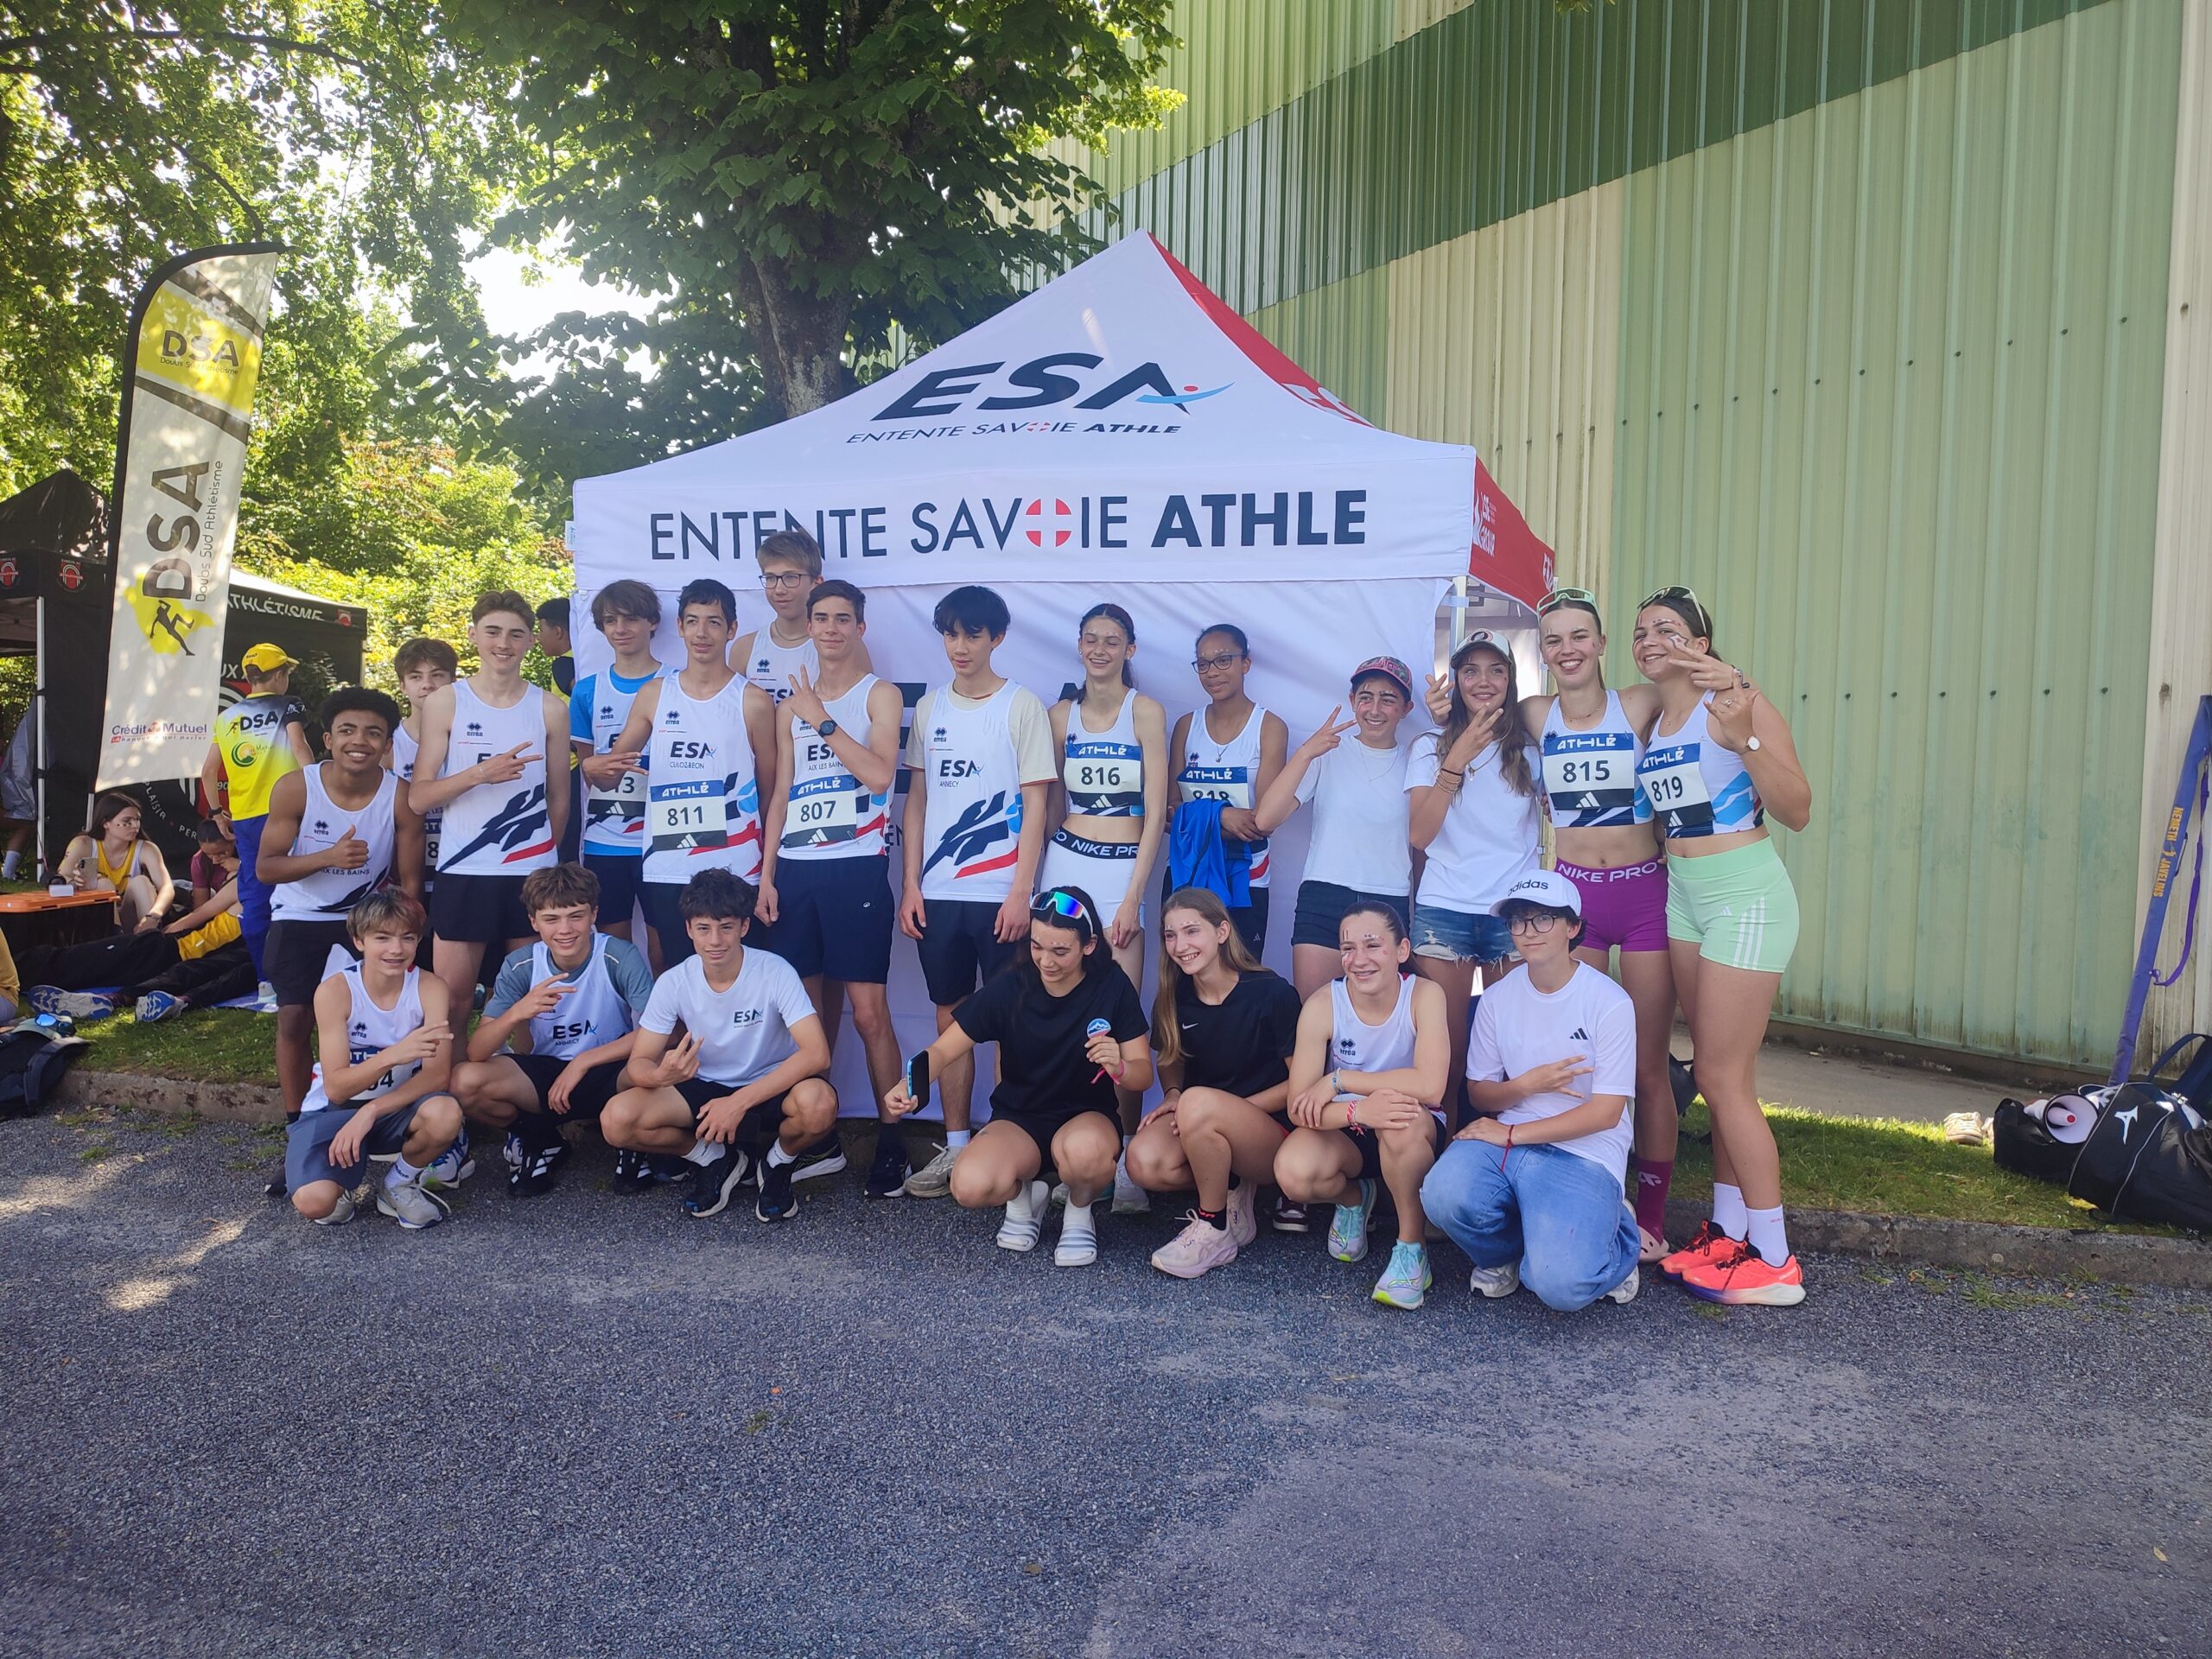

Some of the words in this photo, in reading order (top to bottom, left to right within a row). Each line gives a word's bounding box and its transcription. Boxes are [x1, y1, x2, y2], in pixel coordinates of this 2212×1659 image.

[162, 330, 239, 367] DSA
[871, 352, 1192, 422] ESA
[845, 425, 966, 444] ENTENTE
[1082, 423, 1182, 434] ATHLE
[204, 461, 223, 530] Athlétisme
[1151, 489, 1367, 549] ATHLE
[143, 461, 210, 600] DSA
[200, 534, 213, 559] Sud
[195, 563, 211, 602] Doubs
[111, 724, 147, 735] Crédit
[162, 722, 207, 733] Mutuel
[240, 710, 279, 731] DSA
[670, 741, 715, 760] ESA
[1078, 745, 1128, 756] ATHLÉ
[1557, 734, 1617, 750] ATHLÉ
[1643, 747, 1684, 769] ATHLÉ
[939, 760, 982, 778] ESA
[1081, 766, 1121, 786] 816
[1185, 767, 1233, 780] ATHLÉ
[1562, 760, 1611, 783] 815
[662, 781, 709, 798] ATHLÉ
[798, 777, 842, 796] ATHLÉ
[1651, 776, 1683, 803] 819
[667, 805, 704, 827] 811
[800, 800, 836, 823] 807
[2166, 806, 2184, 842] NEMETH
[1071, 839, 1113, 856] NIKE
[1558, 863, 1605, 883] NIKE
[1609, 861, 1658, 883] PRO
[2153, 857, 2171, 898] JAVELINS
[1507, 879, 1548, 897] adidas
[734, 1008, 762, 1023] ESA
[553, 1019, 597, 1039] ESA
